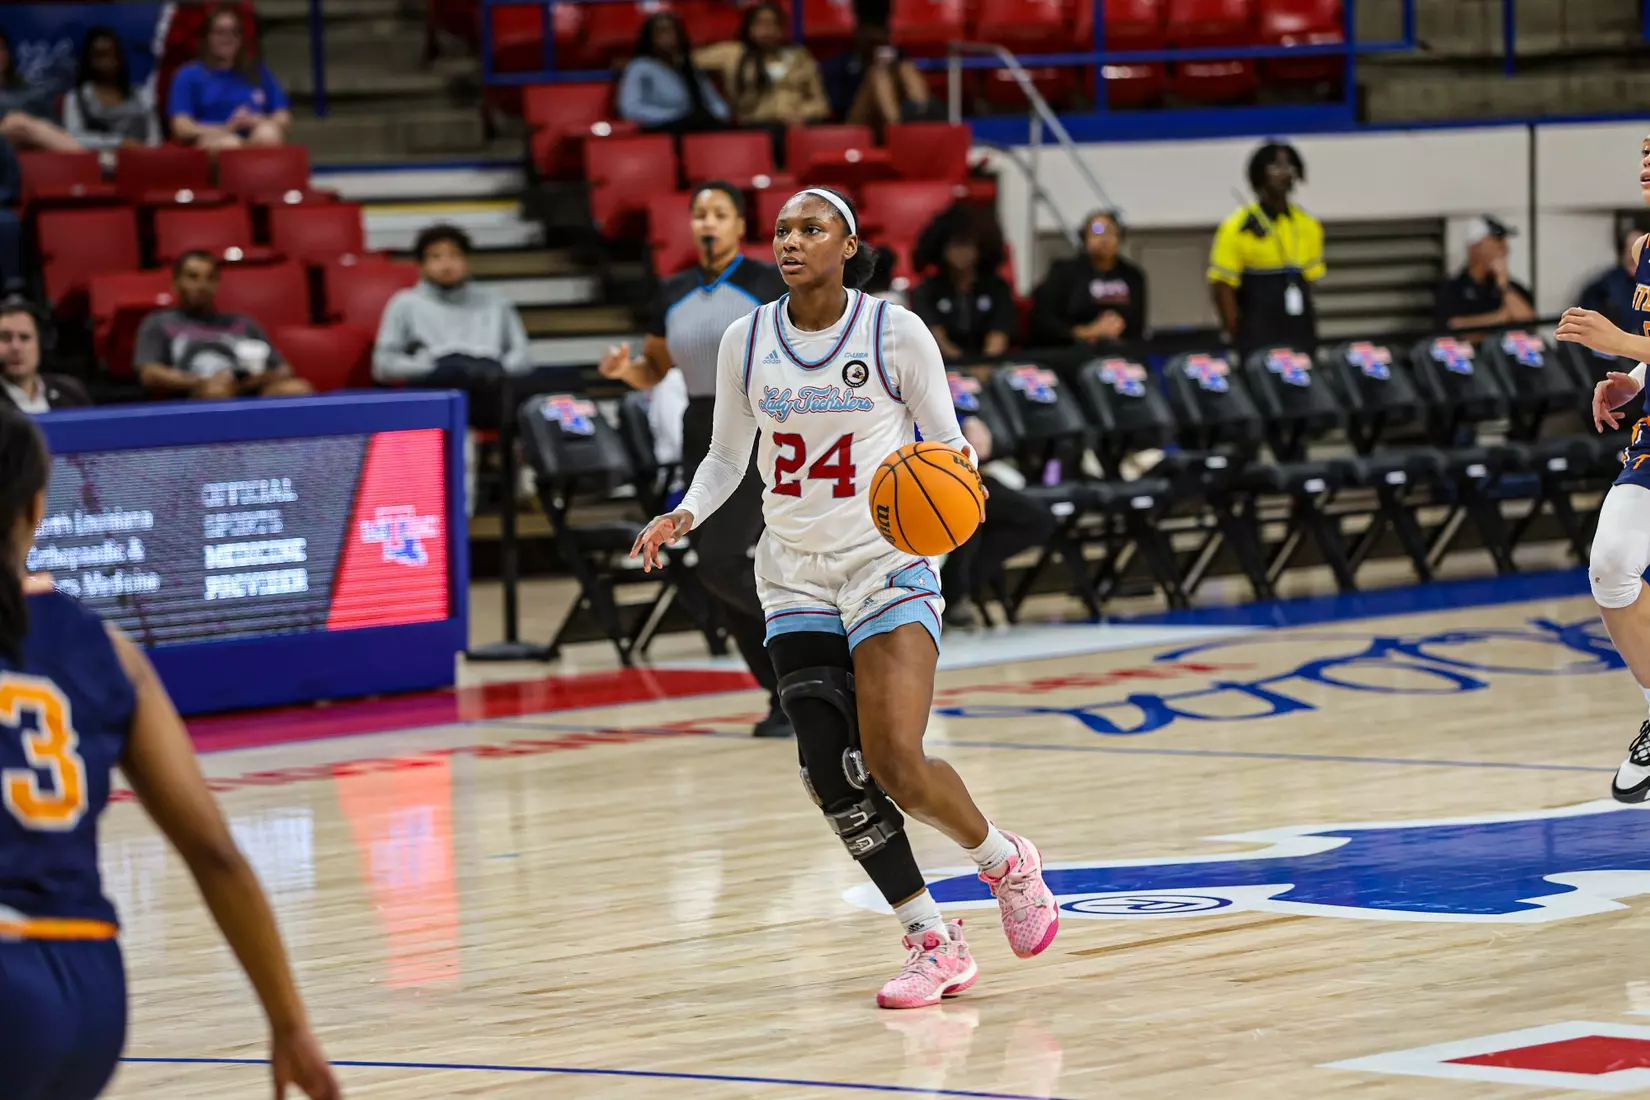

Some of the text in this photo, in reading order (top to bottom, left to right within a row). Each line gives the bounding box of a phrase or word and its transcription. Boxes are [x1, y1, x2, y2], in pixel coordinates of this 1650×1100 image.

[758, 385, 874, 423] Lady Techsters
[771, 432, 856, 498] 24
[0, 670, 88, 832] 3
